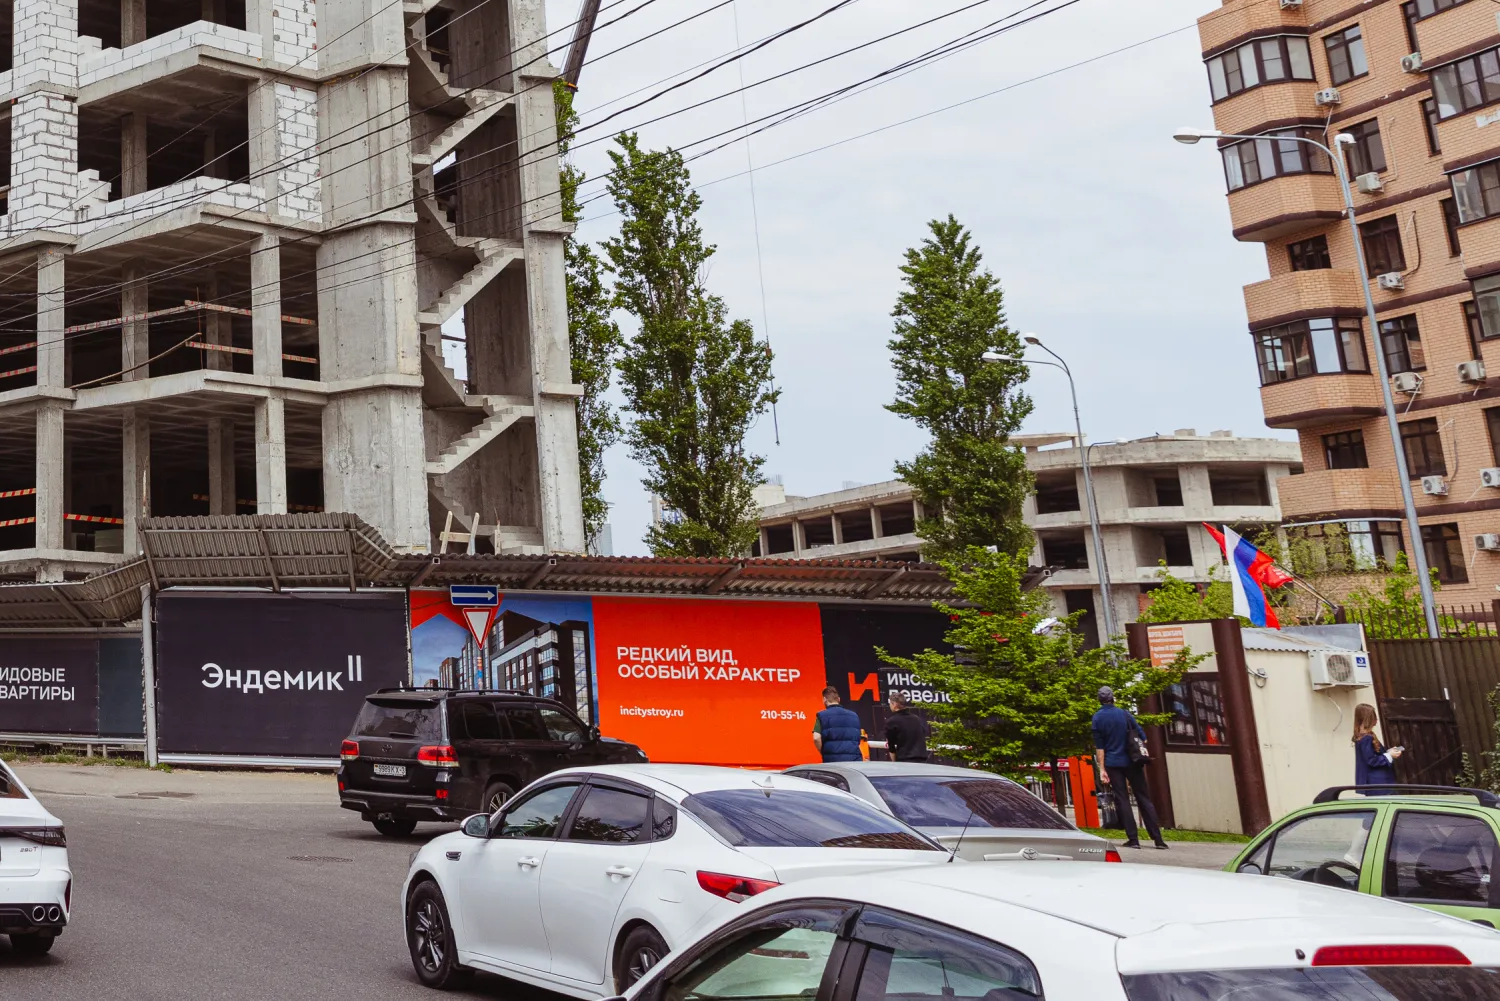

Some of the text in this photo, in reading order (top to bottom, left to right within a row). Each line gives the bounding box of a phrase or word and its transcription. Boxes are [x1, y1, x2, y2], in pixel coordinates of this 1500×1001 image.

[617, 644, 738, 666] РЕДКИЙ ВИД,
[201, 662, 344, 694] Эндемик
[617, 663, 801, 683] ОСОБЫЙ ХАРАКТЕР
[619, 705, 684, 719] incitystroy.ru
[760, 709, 806, 720] 210-55-14
